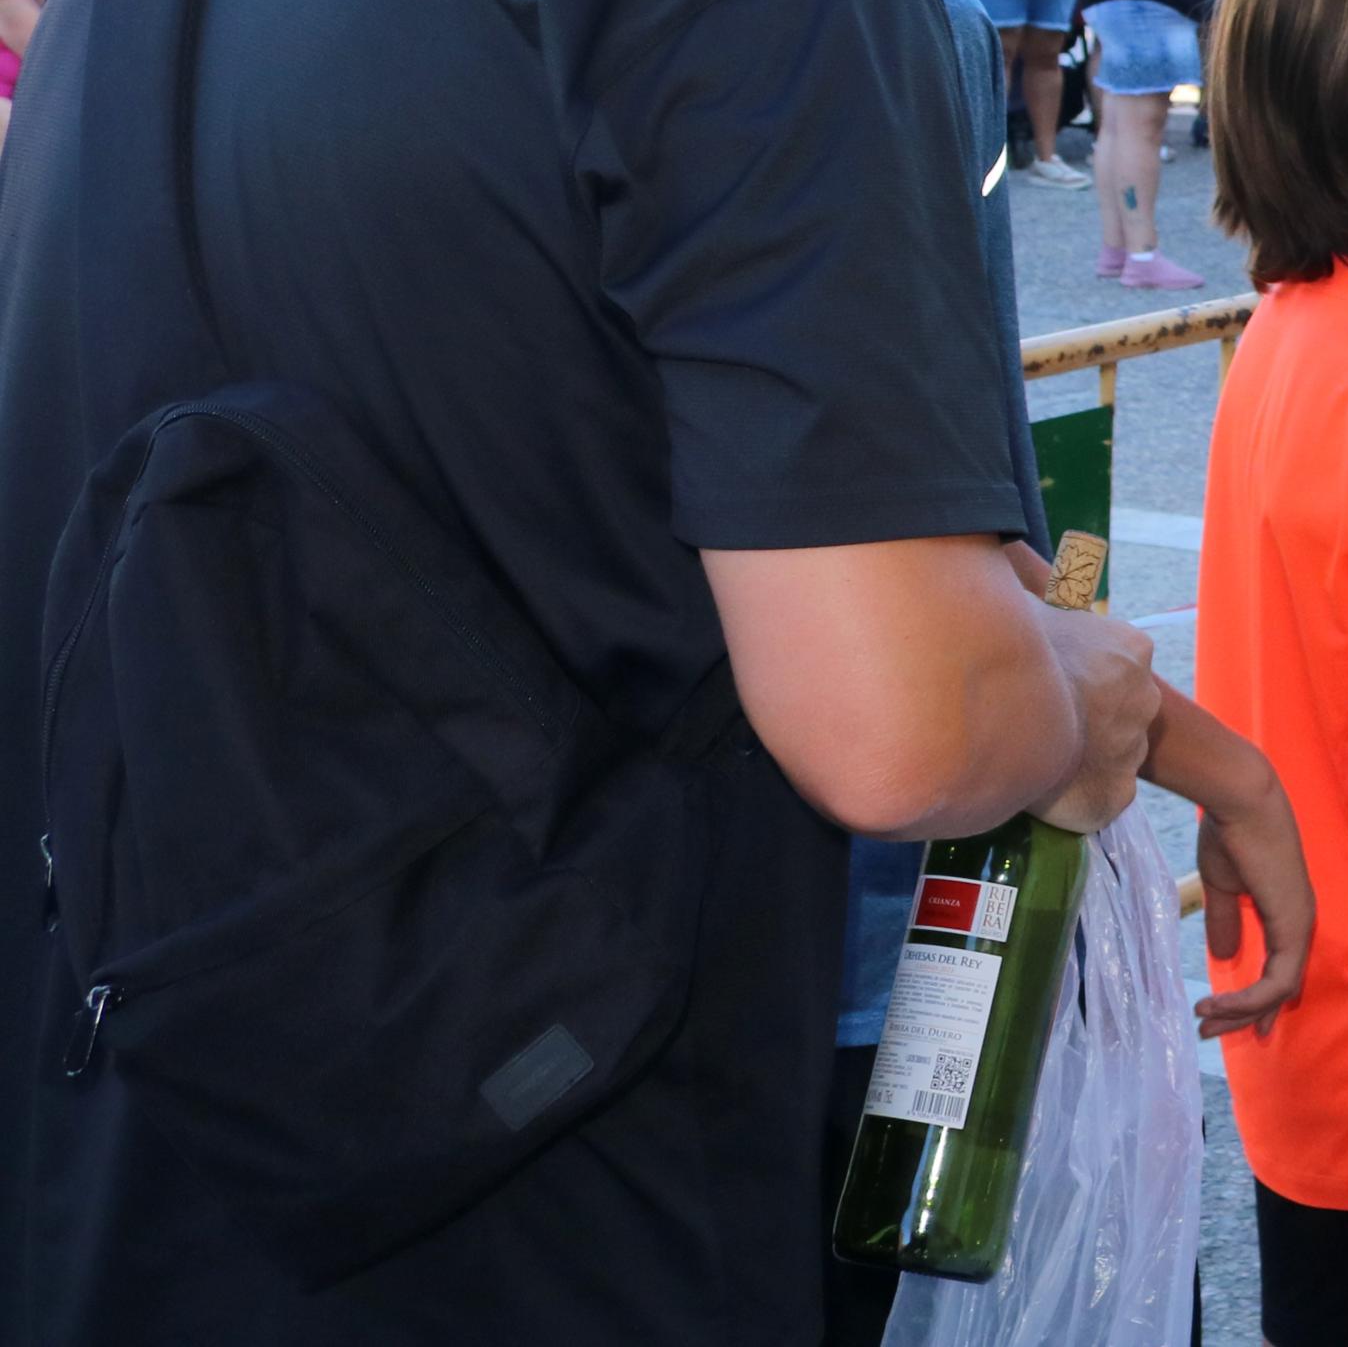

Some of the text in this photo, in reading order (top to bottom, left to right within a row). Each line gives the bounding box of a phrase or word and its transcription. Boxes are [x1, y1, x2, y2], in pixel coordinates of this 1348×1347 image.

[928, 897, 961, 909] CRIANZA
[903, 949, 937, 963] DEHESAS
[937, 954, 958, 966] DEL
[960, 955, 983, 970] REY
[927, 1027, 963, 1042] DUERO
